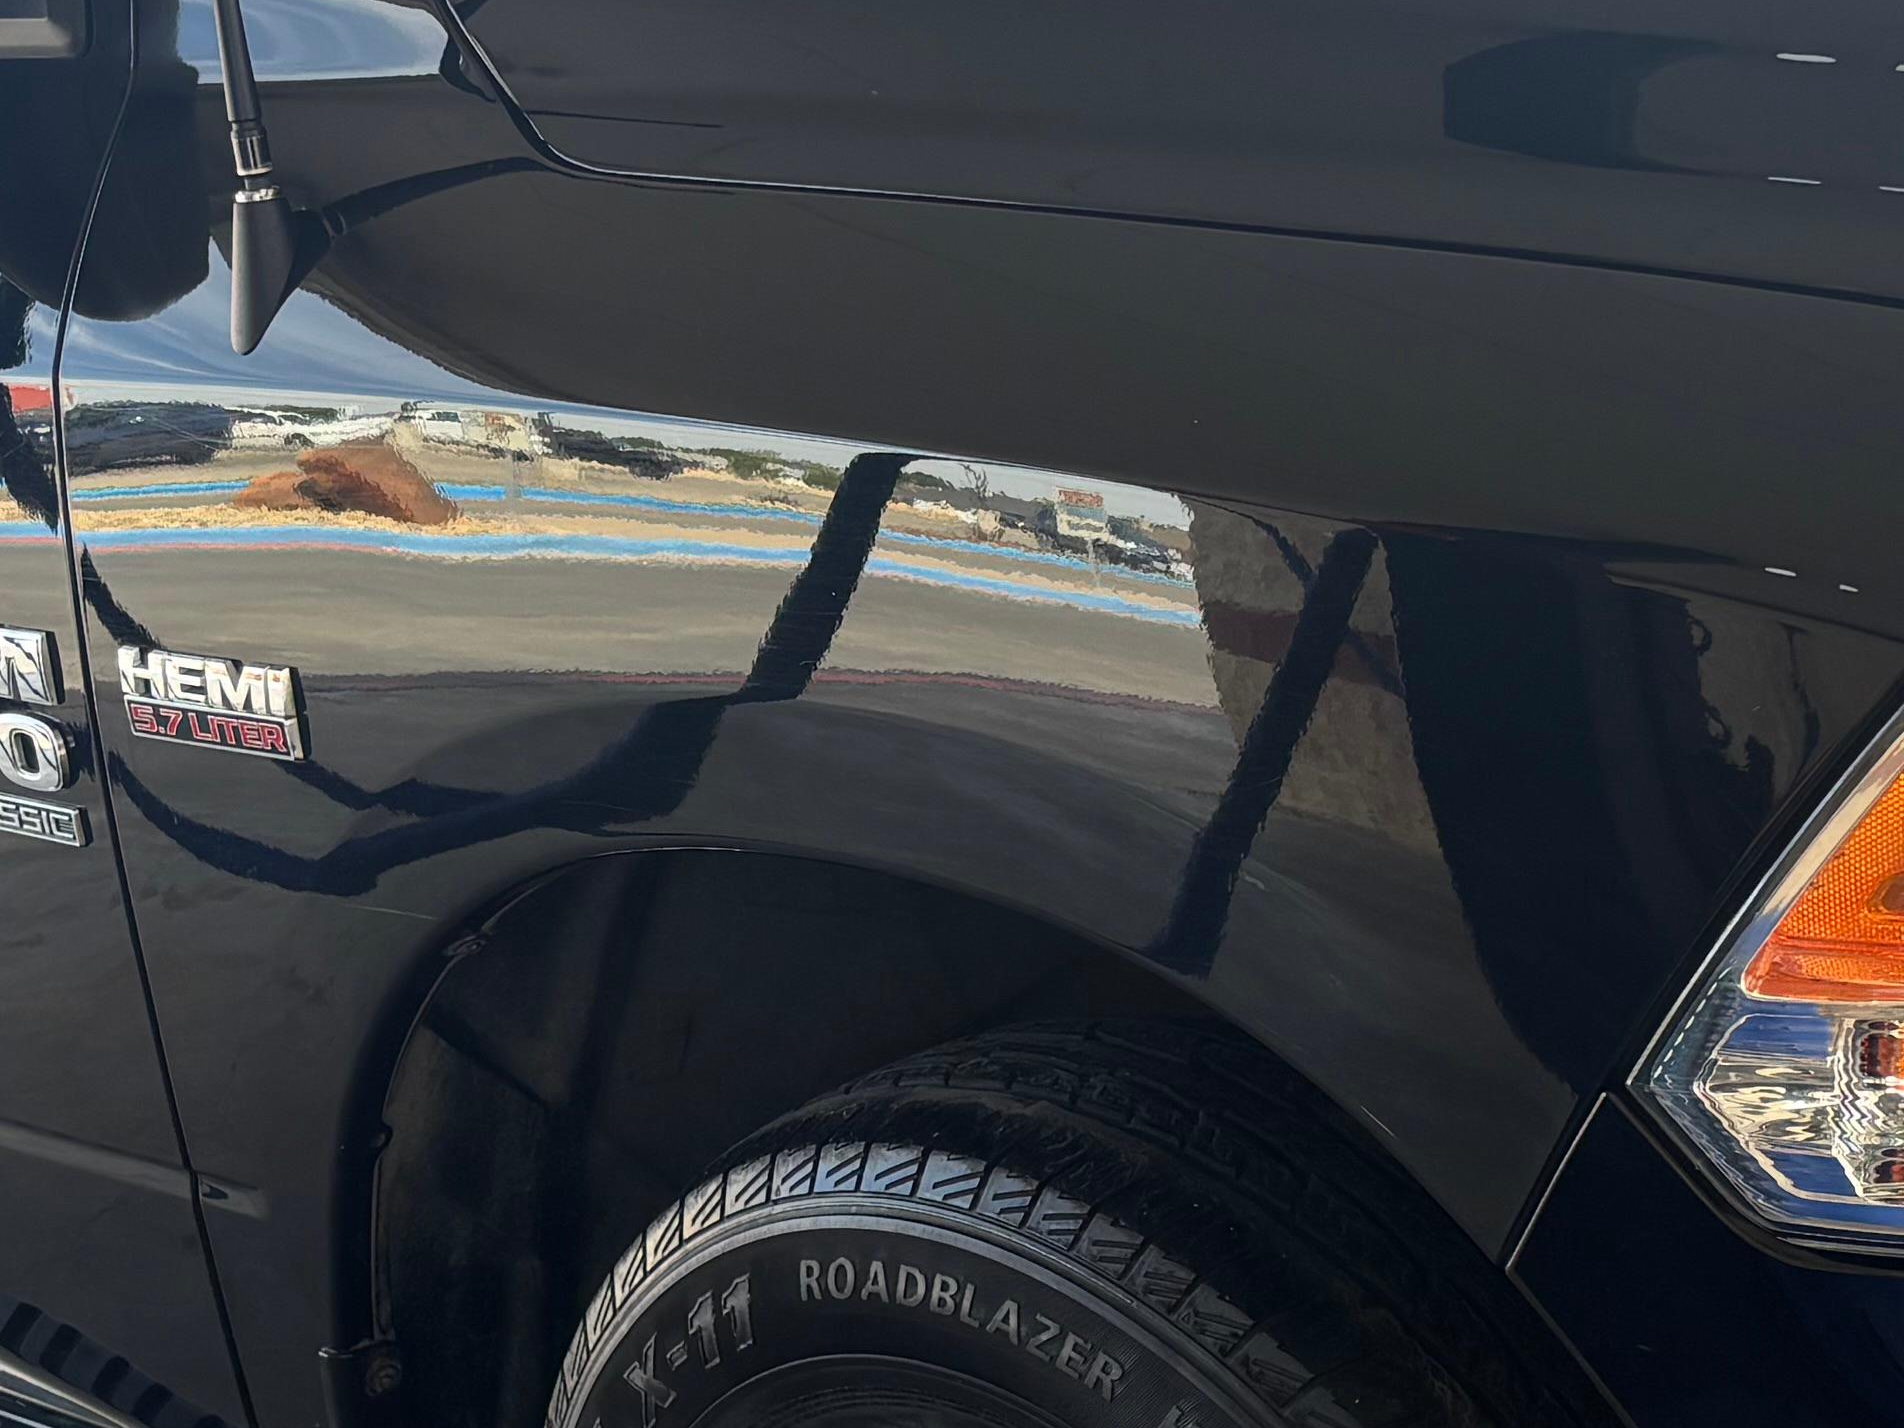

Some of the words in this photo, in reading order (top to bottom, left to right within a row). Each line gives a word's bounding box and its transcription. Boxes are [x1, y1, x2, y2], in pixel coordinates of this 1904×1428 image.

[117, 645, 300, 718] HEMI
[131, 704, 180, 737] 5.7
[190, 713, 287, 752] LITER
[798, 1257, 1125, 1403] ROADBLAZER
